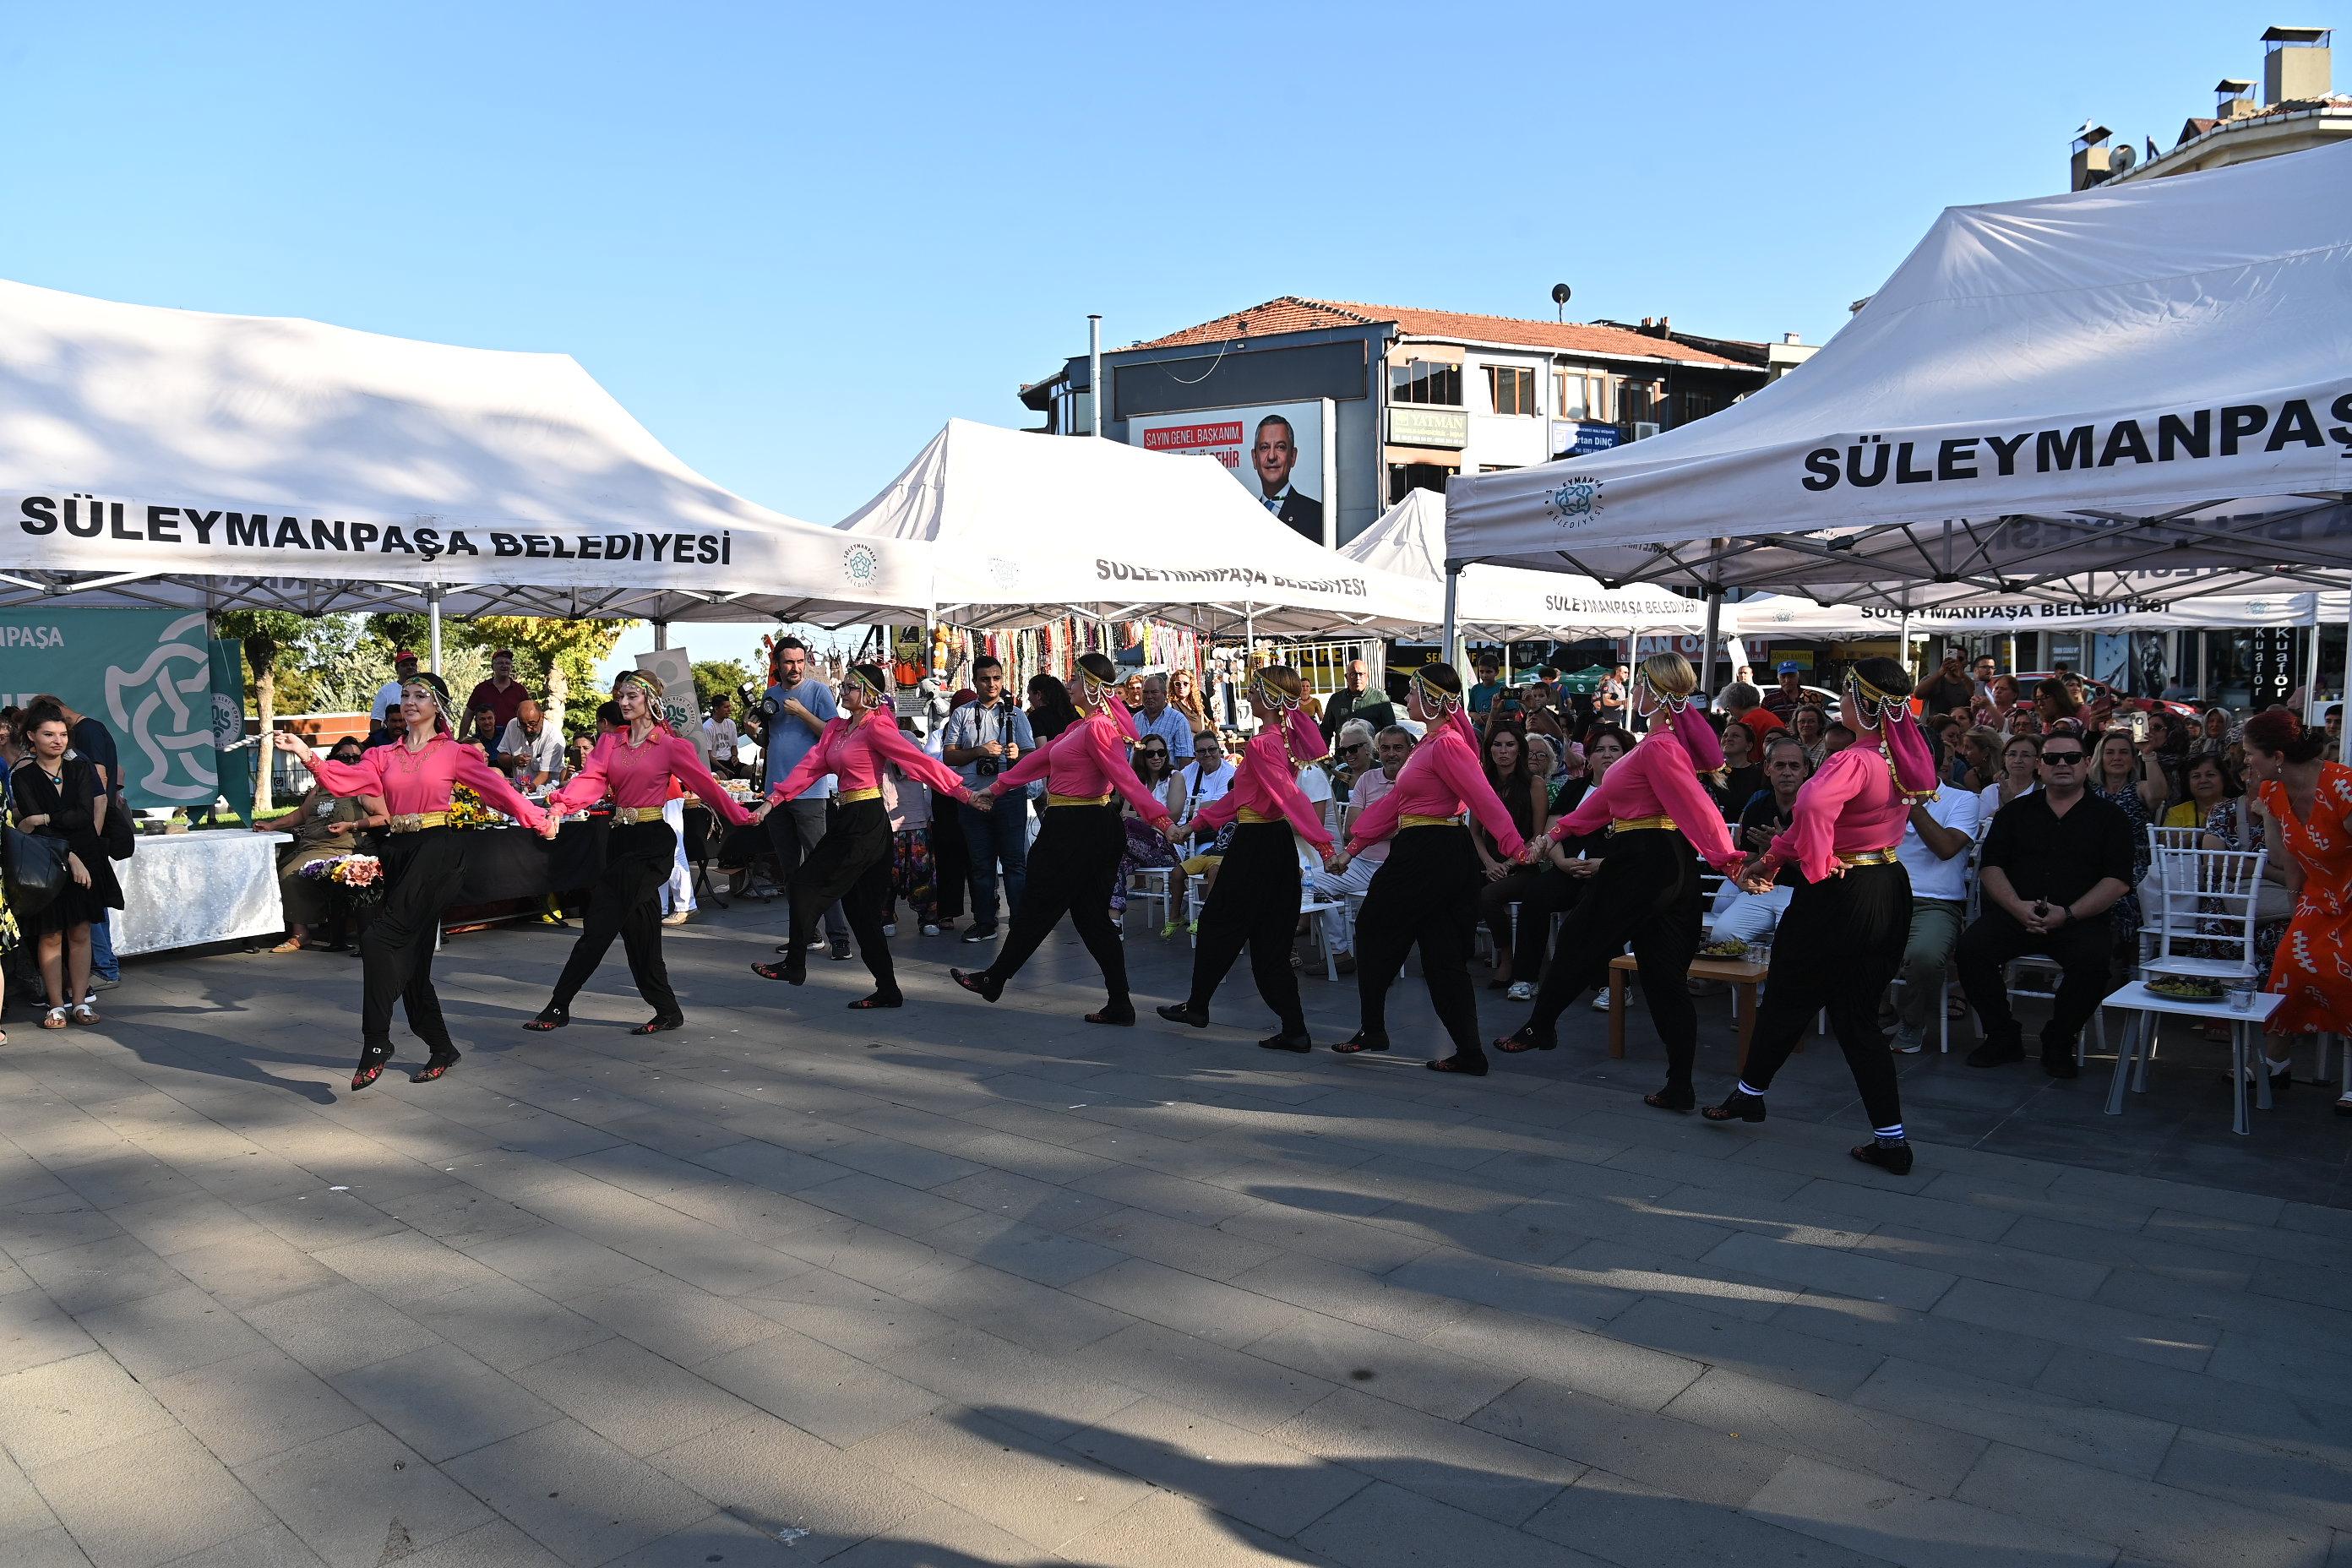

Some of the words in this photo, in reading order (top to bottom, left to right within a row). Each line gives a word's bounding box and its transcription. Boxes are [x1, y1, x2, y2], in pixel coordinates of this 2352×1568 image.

[1146, 432, 1169, 447] SAYIN
[1171, 429, 1195, 444] GENEL
[1197, 426, 1241, 444] BAŞKANIM,
[1411, 412, 1463, 429] YATMAN
[19, 493, 477, 561] SÜLEYMANPAŞA
[490, 531, 730, 564] BELEDİYESİ
[2254, 627, 2266, 696] Kuaför
[2273, 627, 2290, 698] Kuaför
